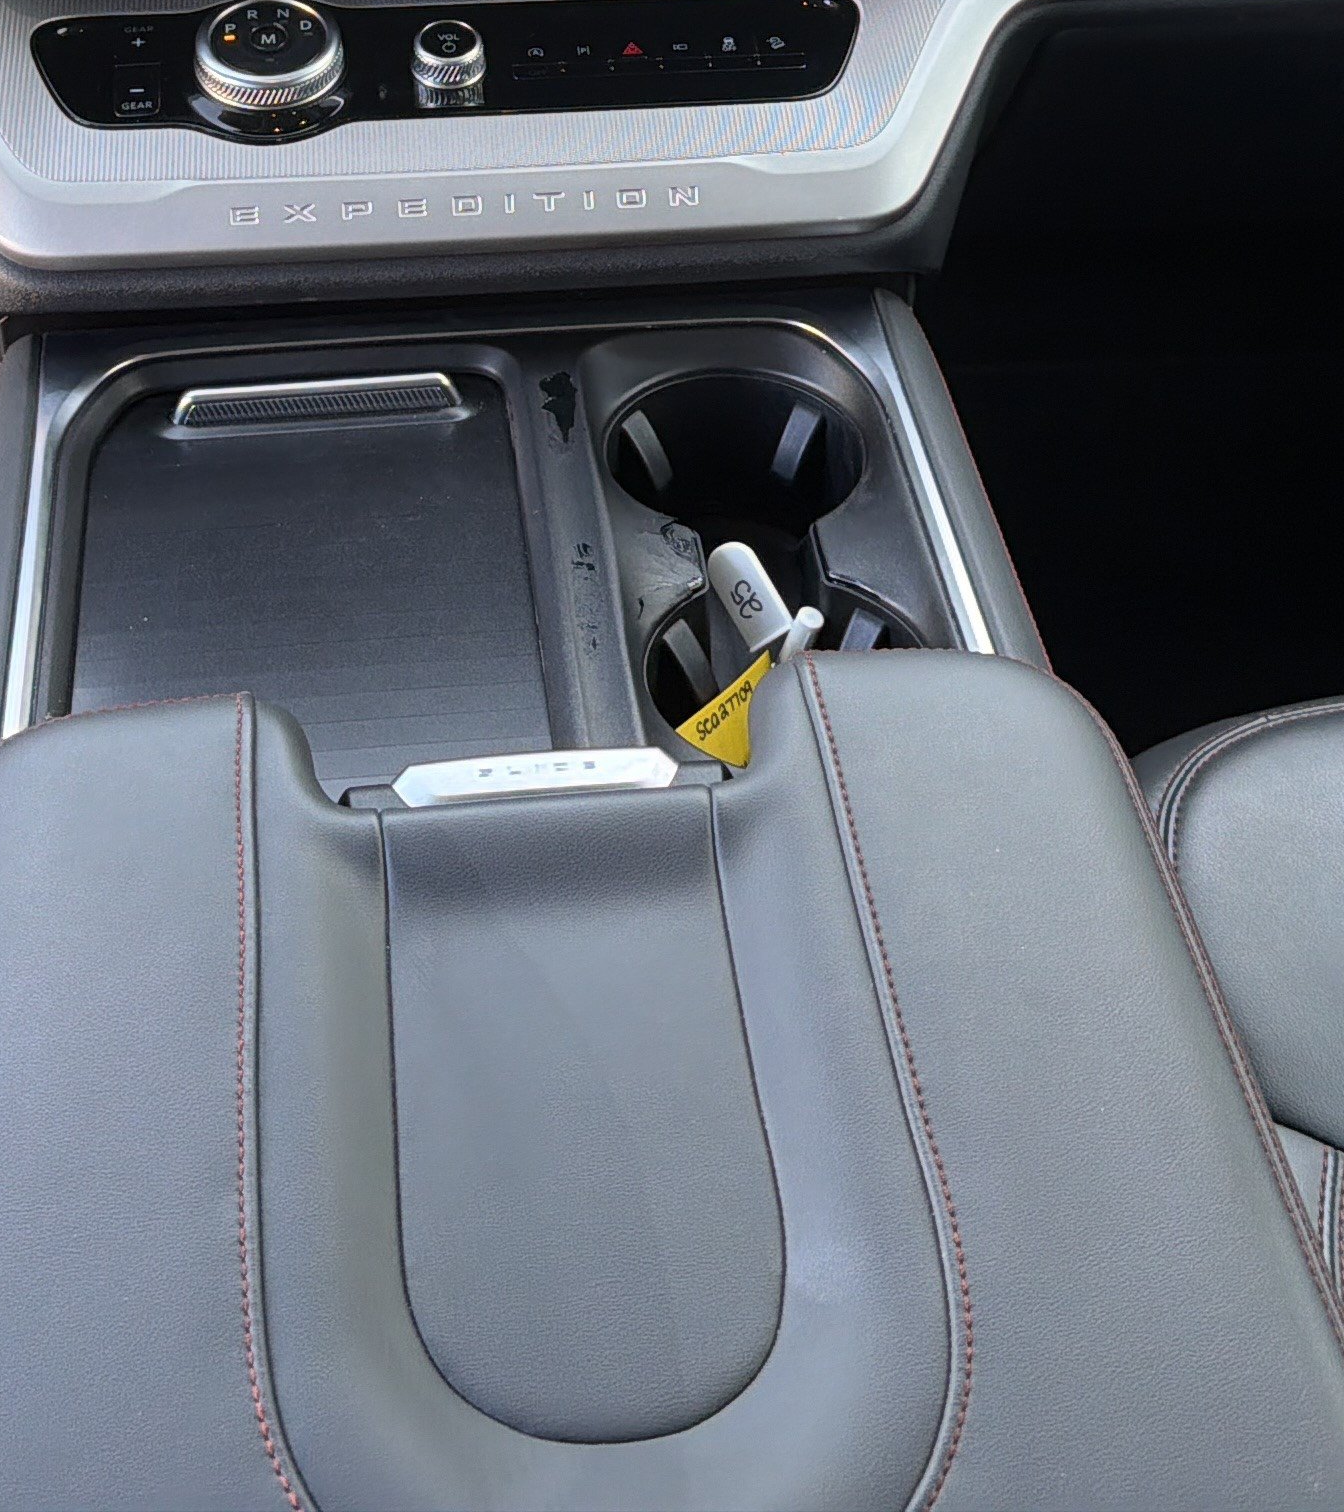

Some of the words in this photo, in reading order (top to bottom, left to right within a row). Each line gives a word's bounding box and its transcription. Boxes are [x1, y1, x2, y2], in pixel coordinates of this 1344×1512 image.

[247, 9, 259, 20] R
[276, 8, 290, 18] N
[123, 25, 154, 34] GEAR
[224, 23, 236, 33] P
[300, 20, 312, 31] D
[260, 33, 276, 45] M
[437, 33, 460, 41] VOL
[121, 100, 153, 111] GEAR
[229, 185, 700, 227] EXPEDITION
